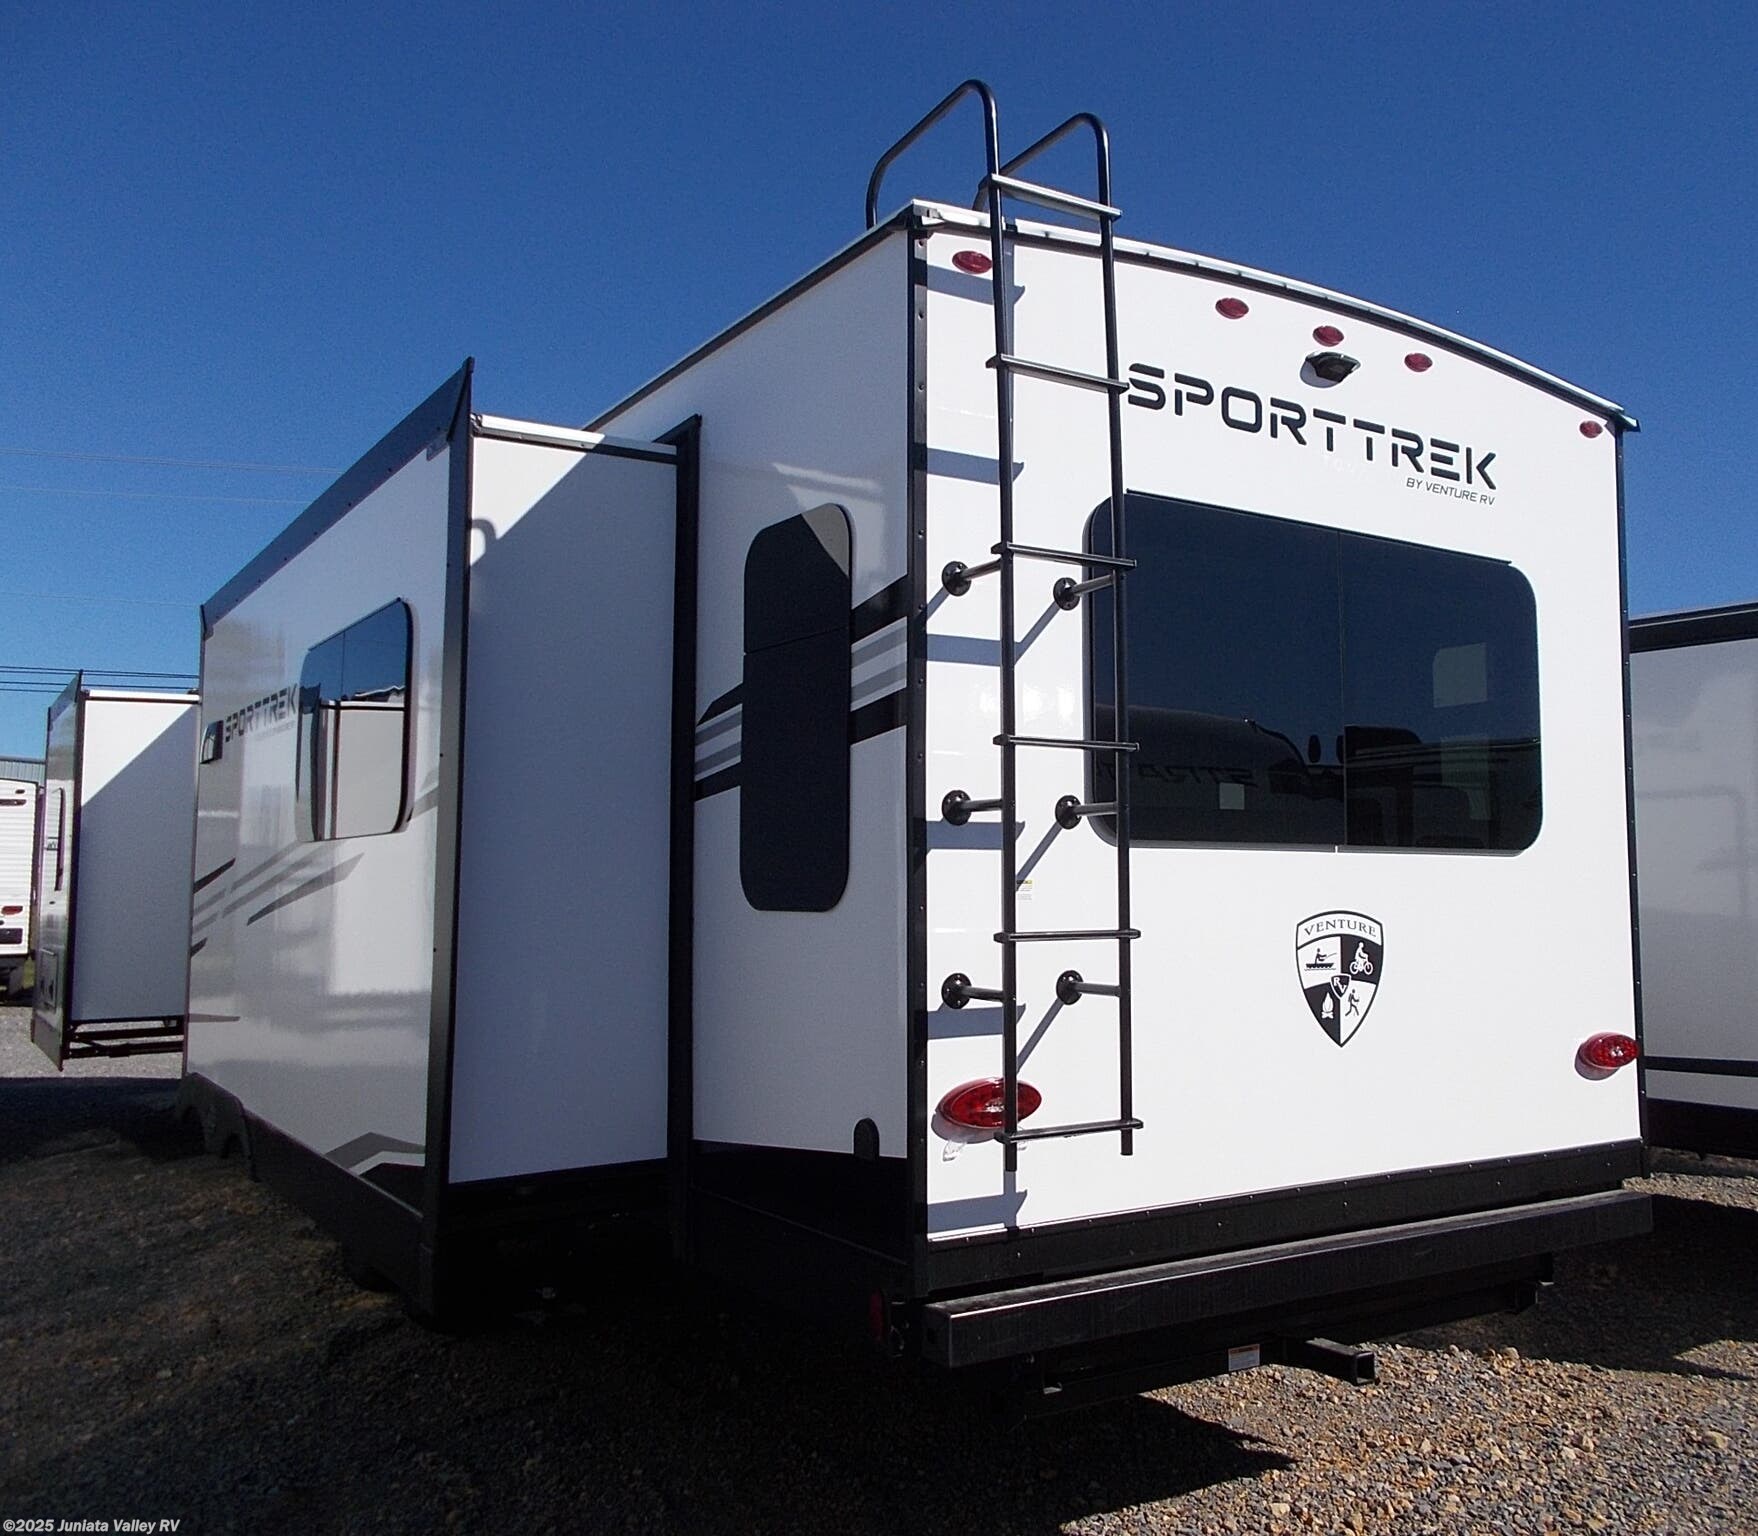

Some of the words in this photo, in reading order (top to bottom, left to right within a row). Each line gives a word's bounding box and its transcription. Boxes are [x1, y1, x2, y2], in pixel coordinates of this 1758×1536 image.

[1128, 363, 1497, 490] SPORTTREK
[1406, 477, 1423, 490] BY
[1425, 481, 1478, 503] VENTURE
[1479, 494, 1496, 506] RV
[1304, 919, 1377, 938] VENTURE
